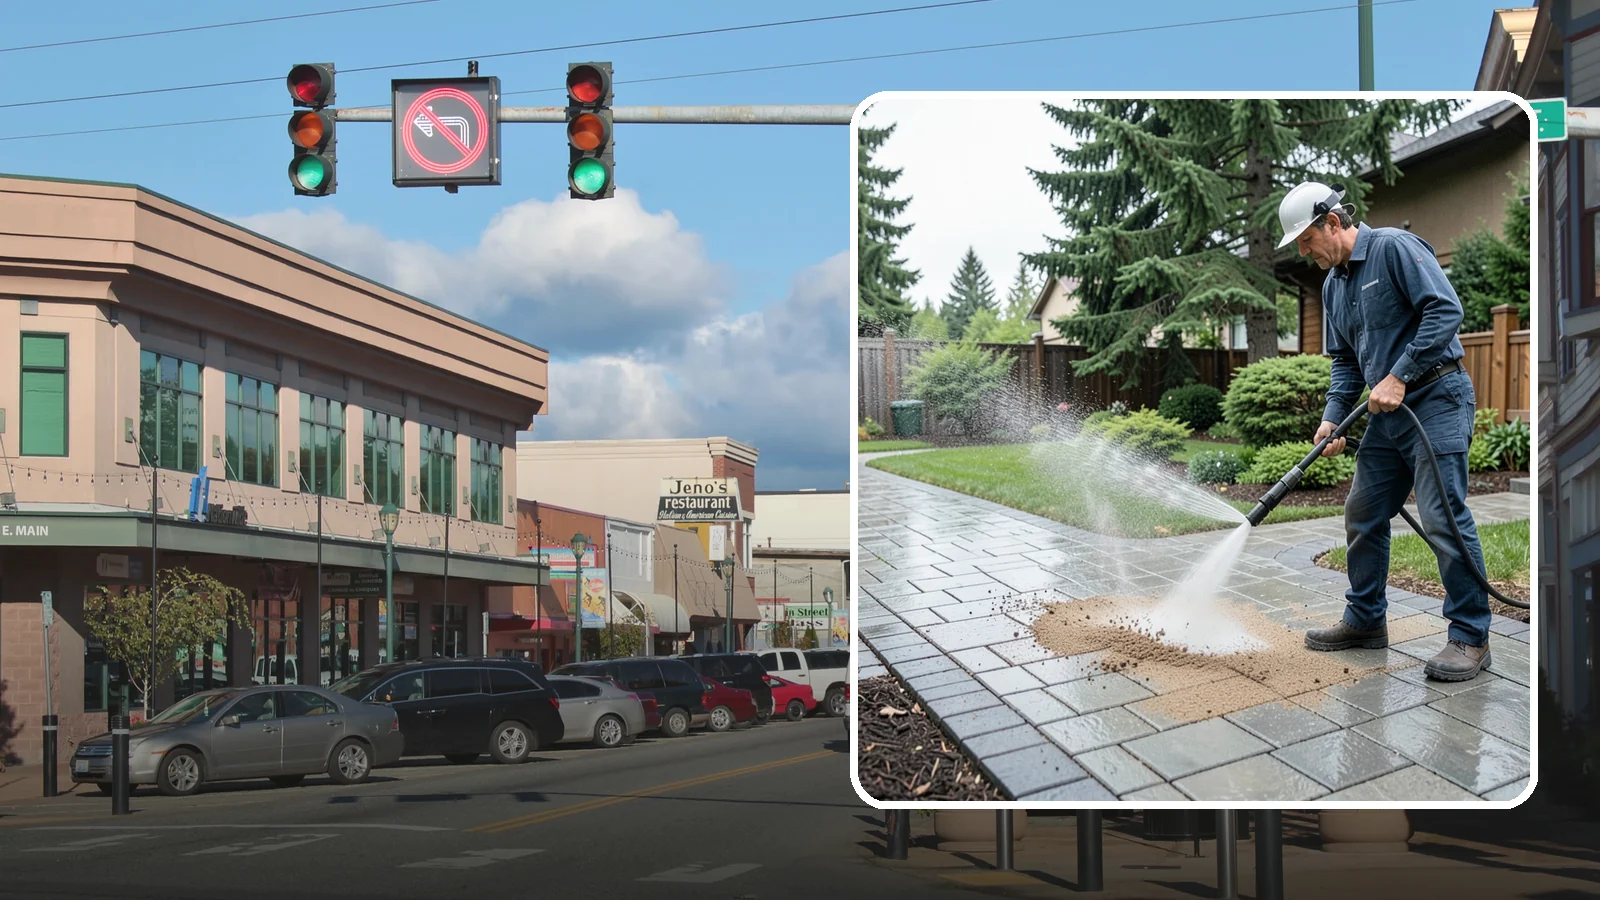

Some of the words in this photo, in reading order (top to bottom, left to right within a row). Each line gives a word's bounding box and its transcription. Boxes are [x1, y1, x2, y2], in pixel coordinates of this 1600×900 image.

[670, 480, 728, 494] Jeno's
[665, 496, 731, 509] restaurant
[686, 510, 714, 519] American
[715, 510, 737, 519] Cuisine
[2, 525, 13, 536] E.
[15, 525, 49, 536] MAIN
[797, 608, 828, 617] Street
